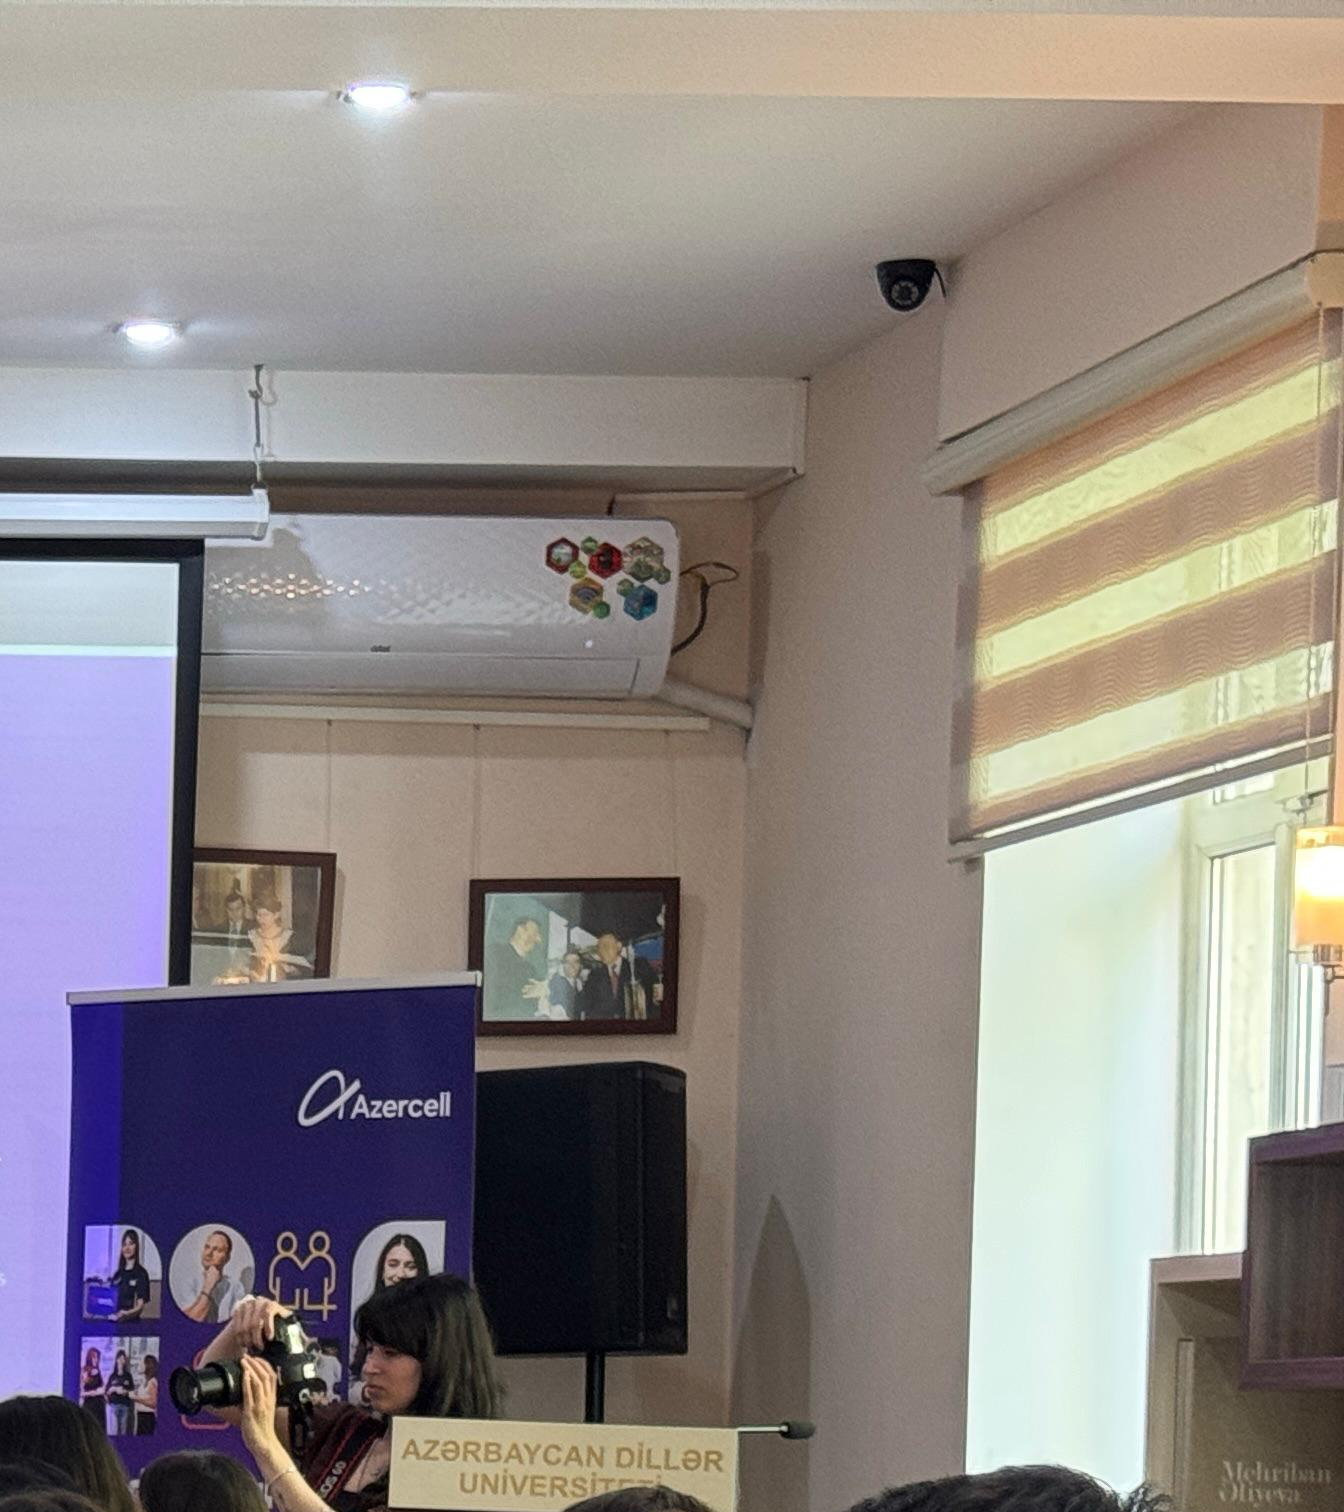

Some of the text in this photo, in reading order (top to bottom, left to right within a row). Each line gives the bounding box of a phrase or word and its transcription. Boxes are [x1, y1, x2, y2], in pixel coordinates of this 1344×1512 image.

[350, 1091, 451, 1120] Azercell
[402, 1438, 723, 1472] AZƏRBAYCAN DİLLƏR
